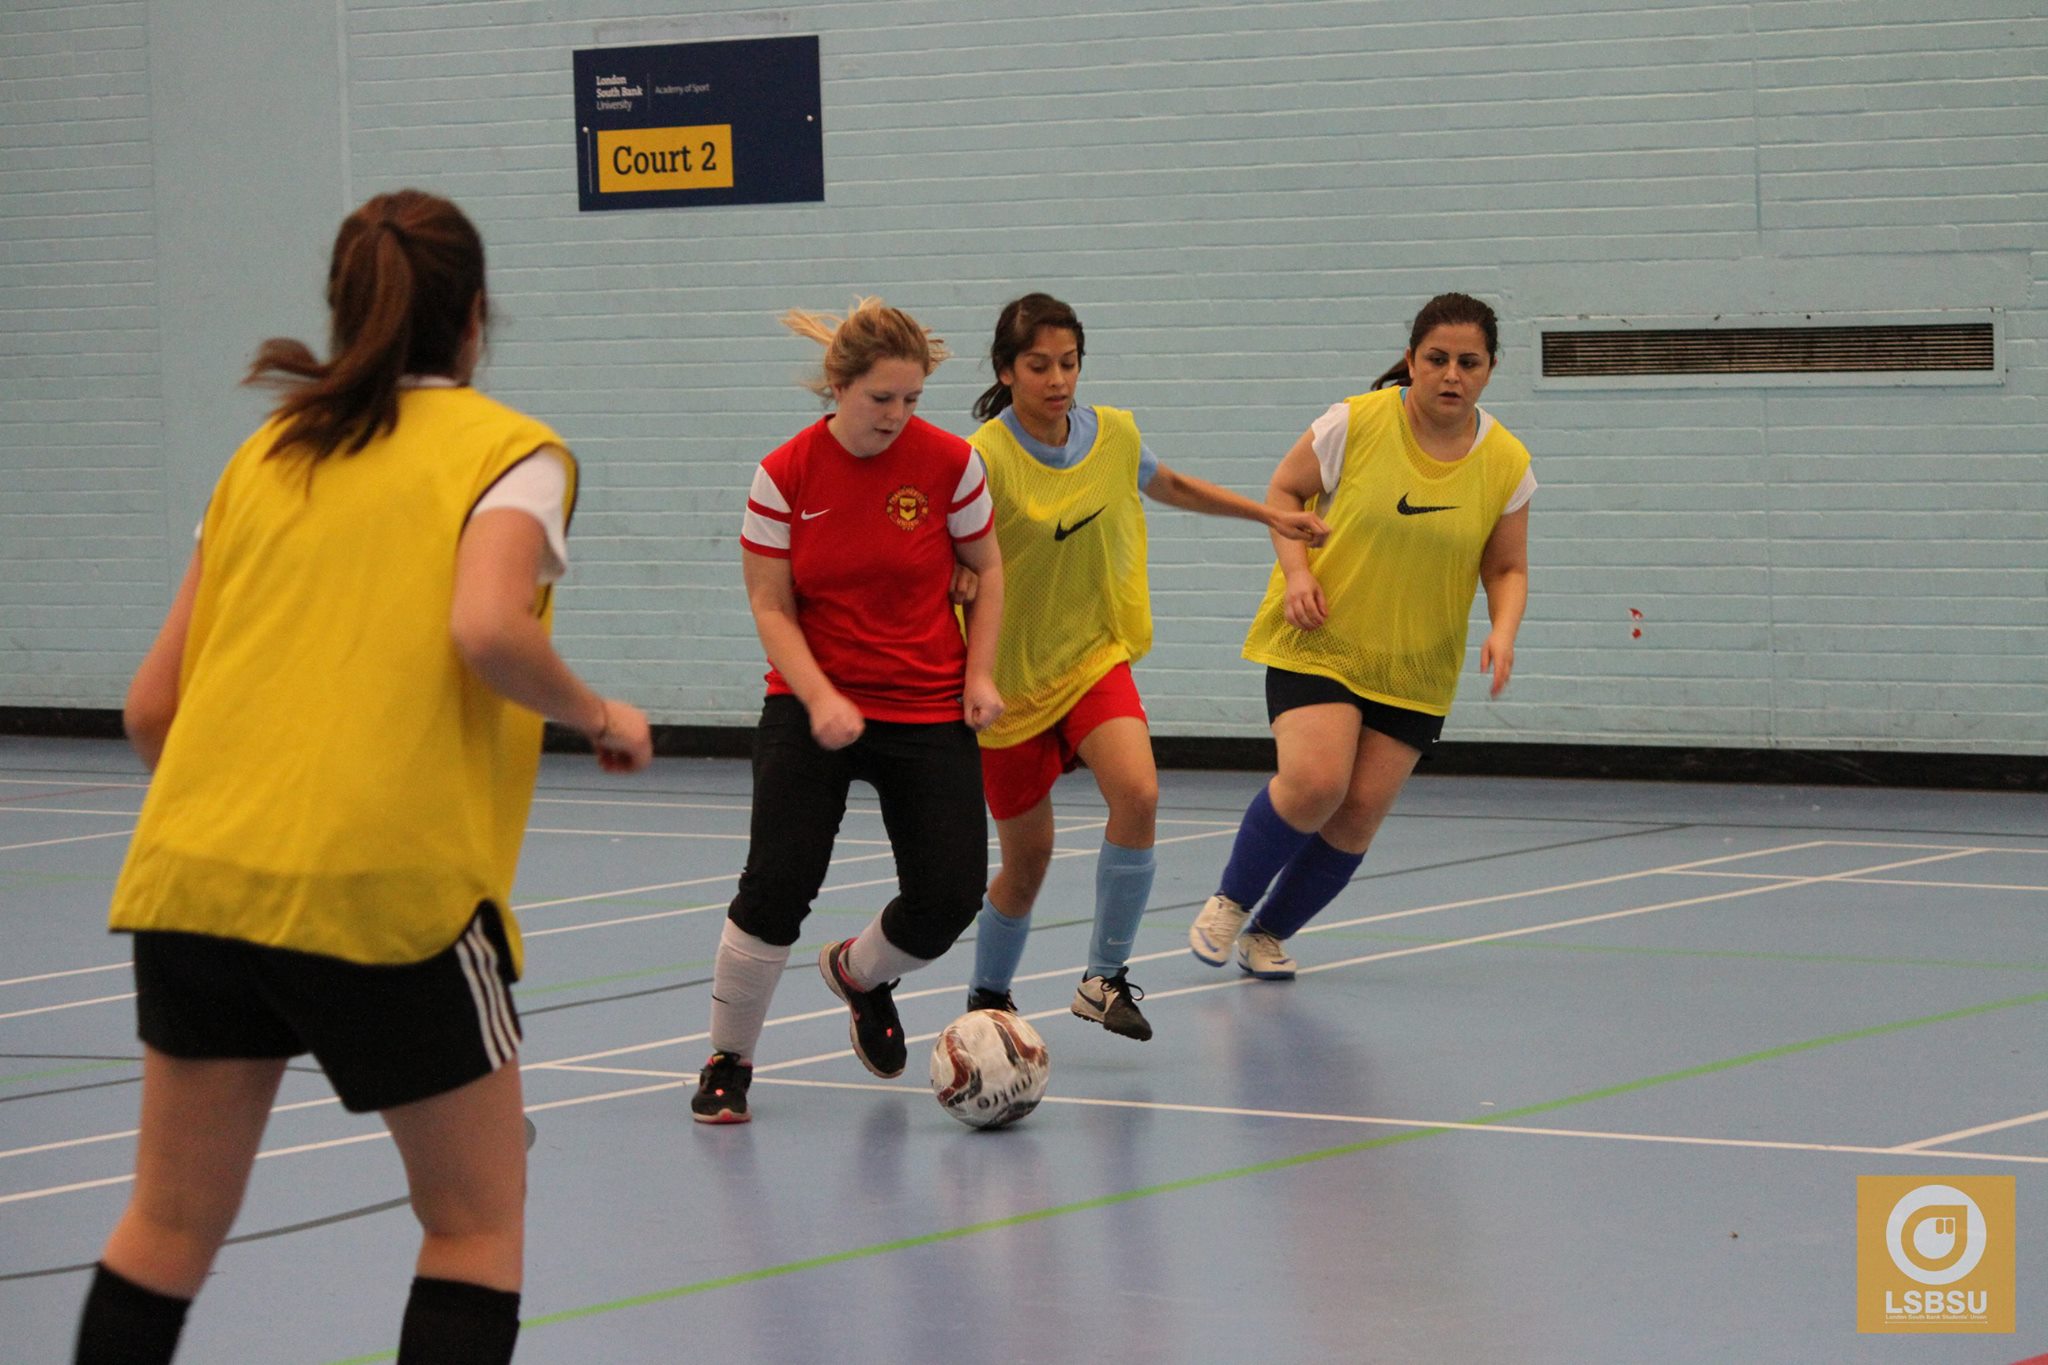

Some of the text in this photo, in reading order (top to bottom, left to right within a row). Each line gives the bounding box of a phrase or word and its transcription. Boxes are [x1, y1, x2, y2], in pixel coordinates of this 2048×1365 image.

[596, 74, 627, 86] London
[596, 85, 643, 98] South Bank
[655, 83, 710, 96] Academy of Sport
[596, 99, 632, 112] University
[613, 141, 717, 175] Court 2
